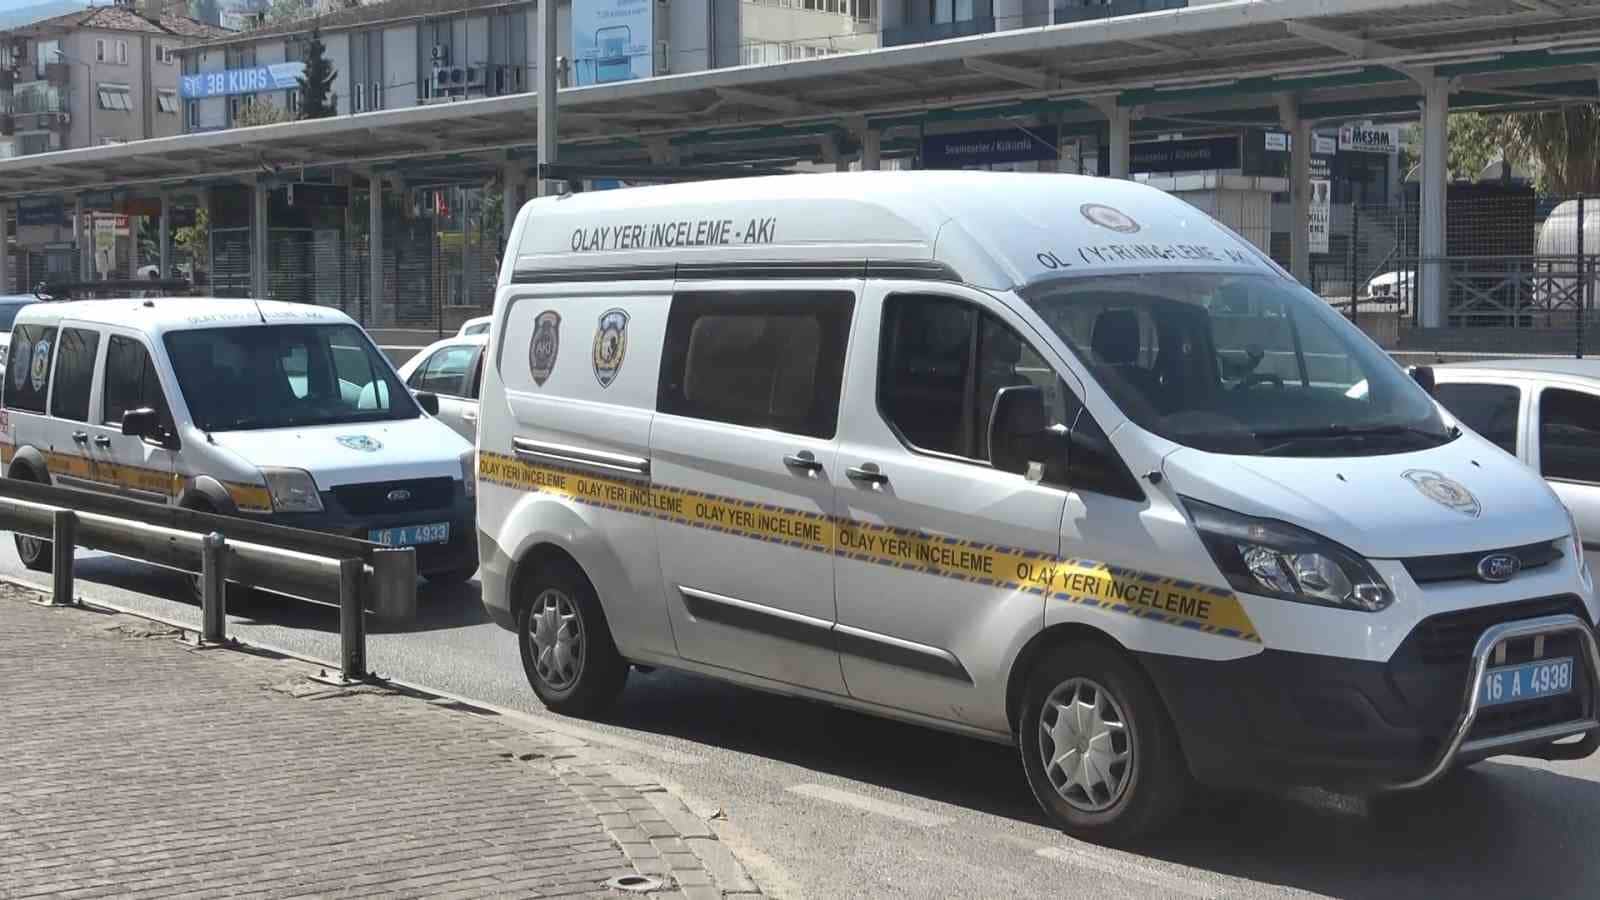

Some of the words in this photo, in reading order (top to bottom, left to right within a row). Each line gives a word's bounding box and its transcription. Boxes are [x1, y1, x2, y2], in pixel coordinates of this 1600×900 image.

[208, 73, 224, 94] 38
[229, 69, 267, 92] KURS
[1352, 127, 1390, 145] MESAM
[571, 227, 609, 251] OLAY
[378, 529, 392, 545] 16
[399, 530, 407, 543] A
[415, 524, 446, 543] 4933
[480, 460, 499, 476] OLAY
[577, 479, 602, 496] OLAY
[695, 503, 727, 522] OLAY
[839, 528, 876, 553] OLAY
[1016, 562, 1056, 585] OLAY
[1486, 673, 1503, 700] 16
[1511, 671, 1521, 696] A
[1531, 663, 1569, 693] 4938
